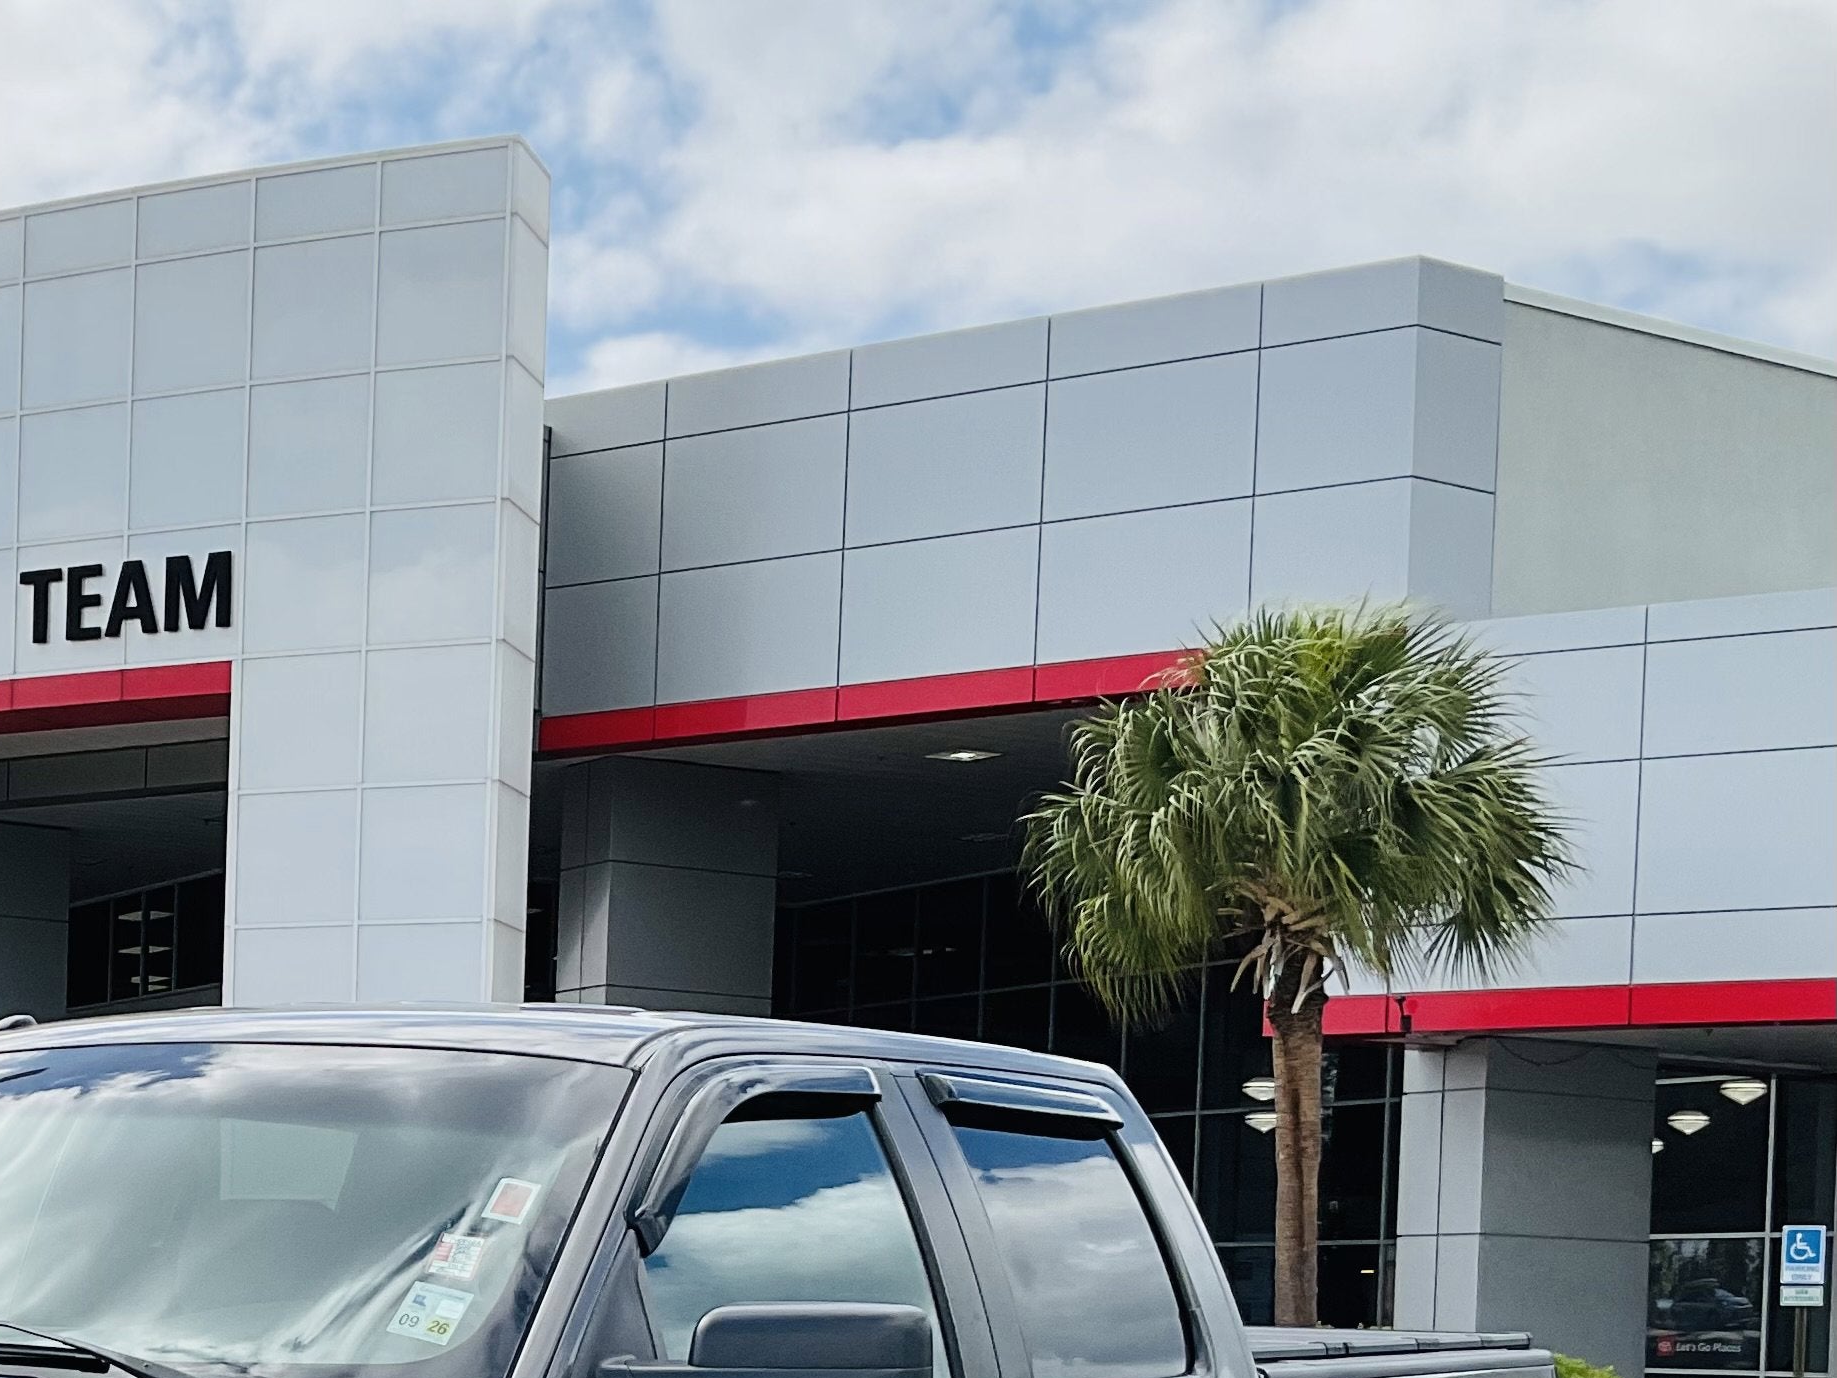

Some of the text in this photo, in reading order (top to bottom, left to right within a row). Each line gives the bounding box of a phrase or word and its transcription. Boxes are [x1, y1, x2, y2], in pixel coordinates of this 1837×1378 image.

[19, 550, 233, 644] TEAM
[398, 1313, 450, 1335] 09 26
[1697, 1342, 1711, 1352] Go
[1713, 1342, 1741, 1352] Places
